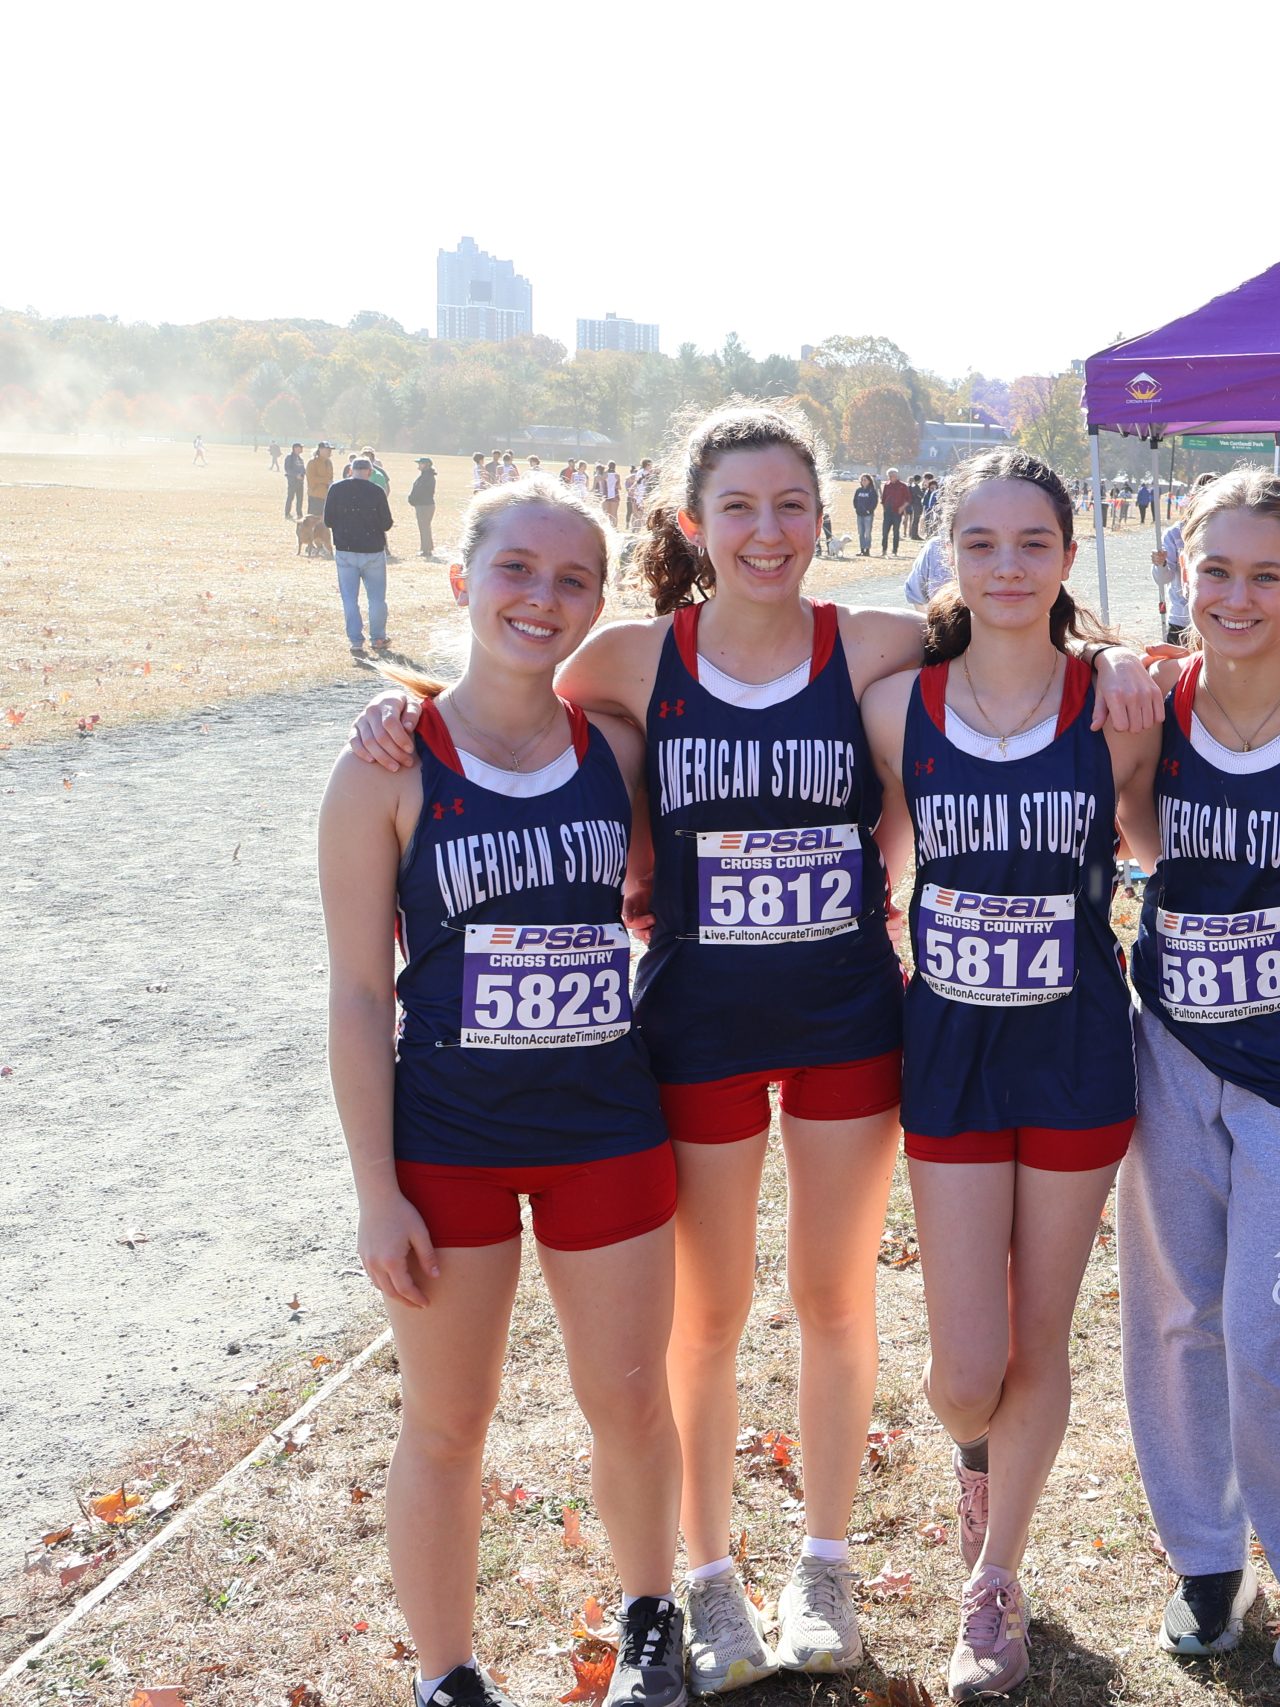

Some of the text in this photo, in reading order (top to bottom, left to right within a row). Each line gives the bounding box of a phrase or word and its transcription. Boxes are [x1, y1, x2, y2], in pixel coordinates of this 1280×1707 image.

[658, 737, 855, 817] AMERICAN STUDIES
[1019, 790, 1096, 867] STUDES
[434, 826, 555, 919] AMERICAN
[720, 852, 842, 870] CROSS COUNTRY
[709, 869, 852, 926] 5812
[934, 913, 1054, 934] CROSS COUNTRY
[489, 951, 613, 968] CROSS COUNTRY
[925, 928, 1063, 988] 5814
[1165, 934, 1276, 952] CROSS COUNTRY
[474, 969, 622, 1029] 5823
